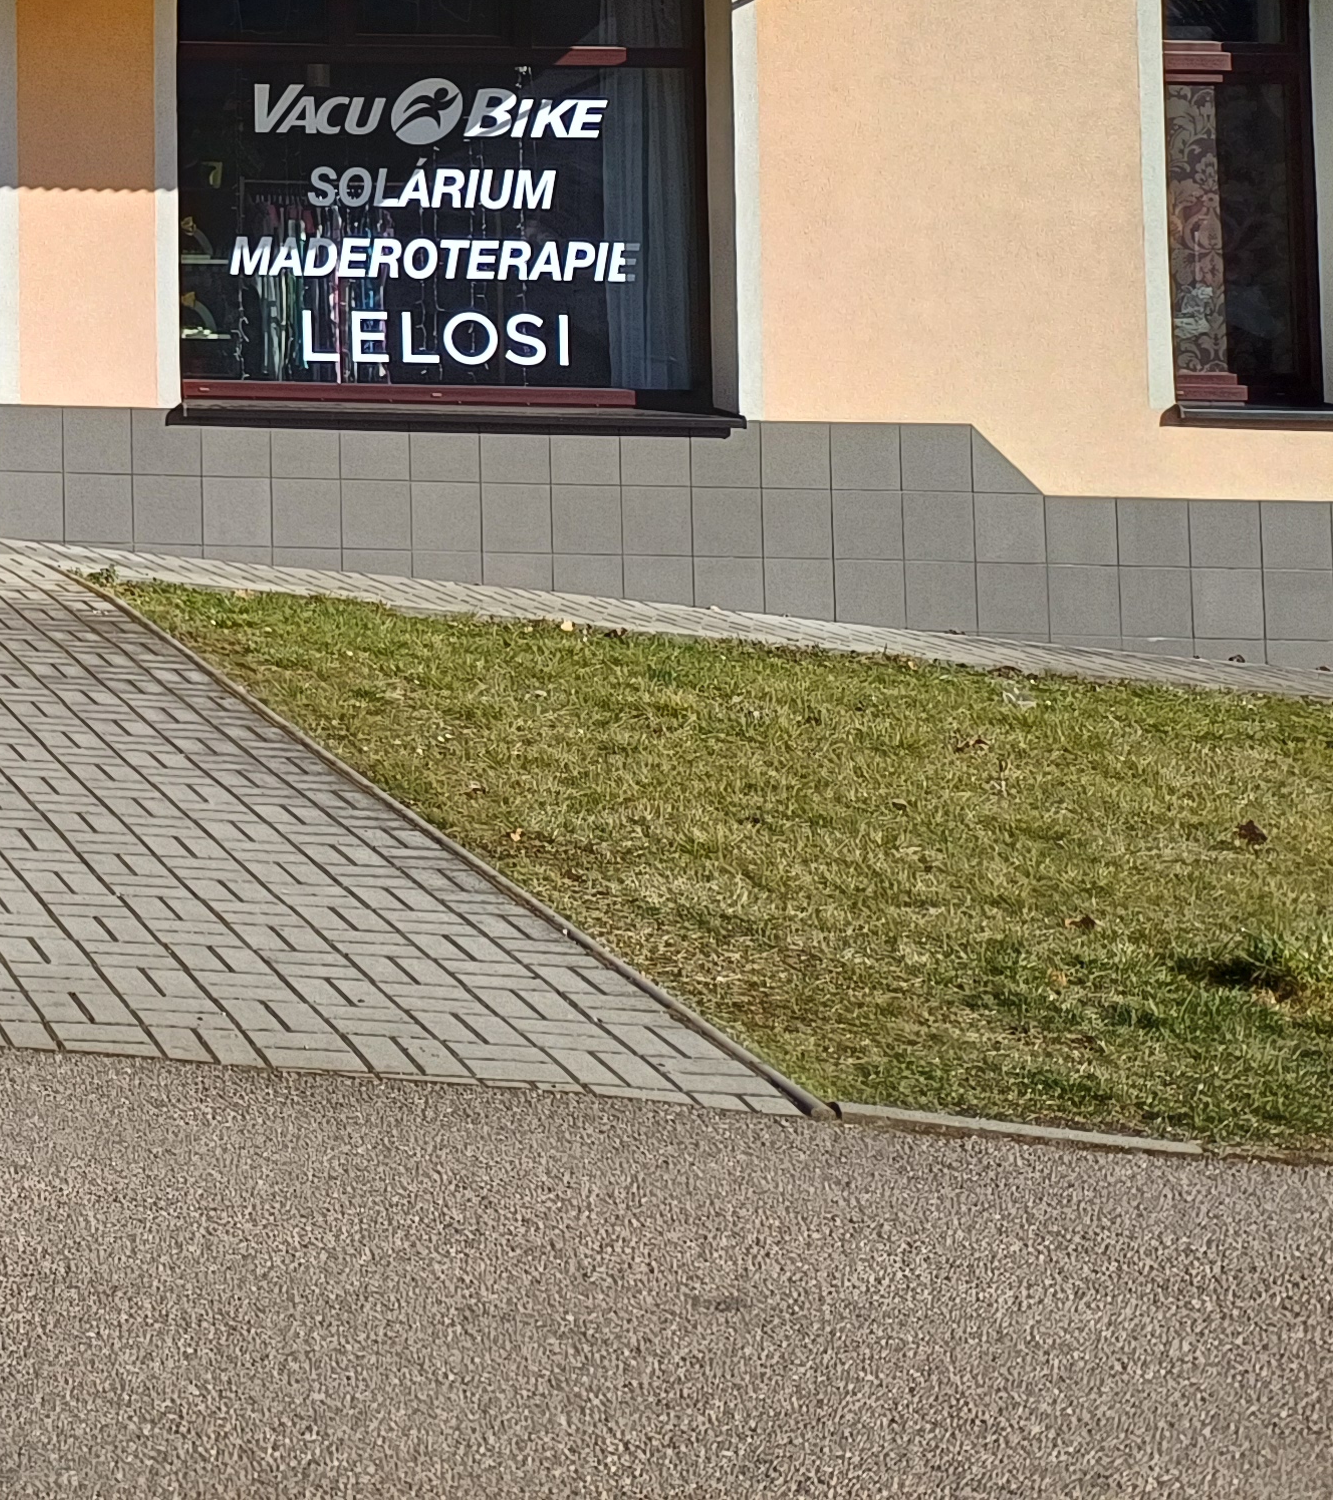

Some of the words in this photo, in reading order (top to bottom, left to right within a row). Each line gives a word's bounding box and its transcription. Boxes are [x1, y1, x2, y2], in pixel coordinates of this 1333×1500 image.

[253, 83, 387, 136] VACU
[463, 87, 608, 140] BIKE
[307, 158, 557, 210] SOLÁRIUM
[230, 236, 641, 283] MADEROTERAPIE
[302, 310, 570, 367] LELOSI
